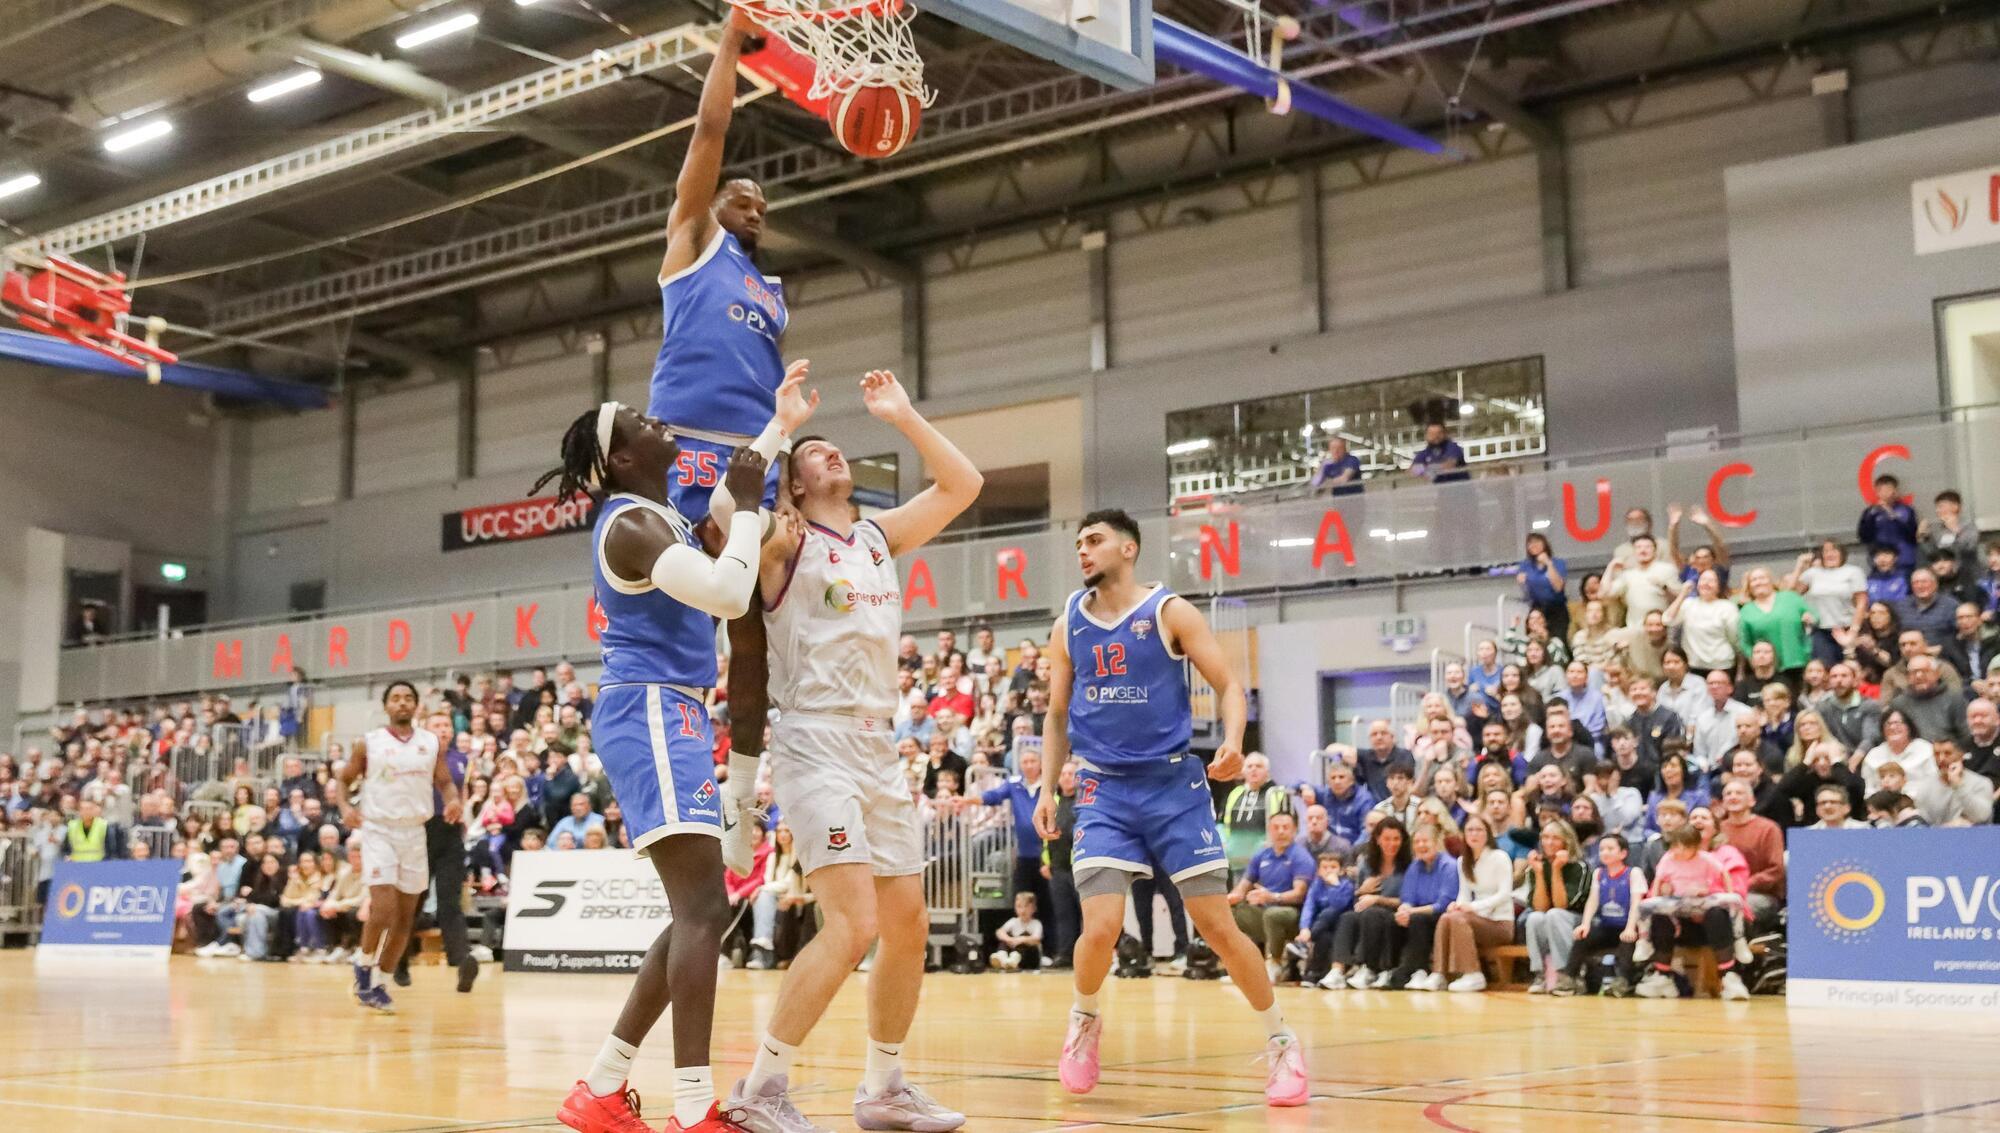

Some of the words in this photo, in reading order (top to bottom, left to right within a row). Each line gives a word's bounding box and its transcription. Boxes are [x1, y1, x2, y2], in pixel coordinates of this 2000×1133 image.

[676, 450, 718, 488] 55
[461, 511, 510, 543] UCC
[512, 497, 592, 536] SPORT
[904, 508, 1356, 611] ARNA
[1562, 444, 1914, 542] UCC
[1092, 642, 1127, 677] 12
[1100, 685, 1148, 699] PVGEN
[87, 885, 168, 914] PVGEN
[581, 878, 662, 900] SKECHE
[579, 904, 672, 920] BASKETBA
[1907, 926, 1993, 941] IRELAND'S
[523, 953, 560, 969] Proudly
[560, 954, 604, 969] Supports
[605, 954, 629, 968] UCC
[1827, 986, 1899, 1005] Principal
[1903, 989, 1974, 1008] Sponsor
